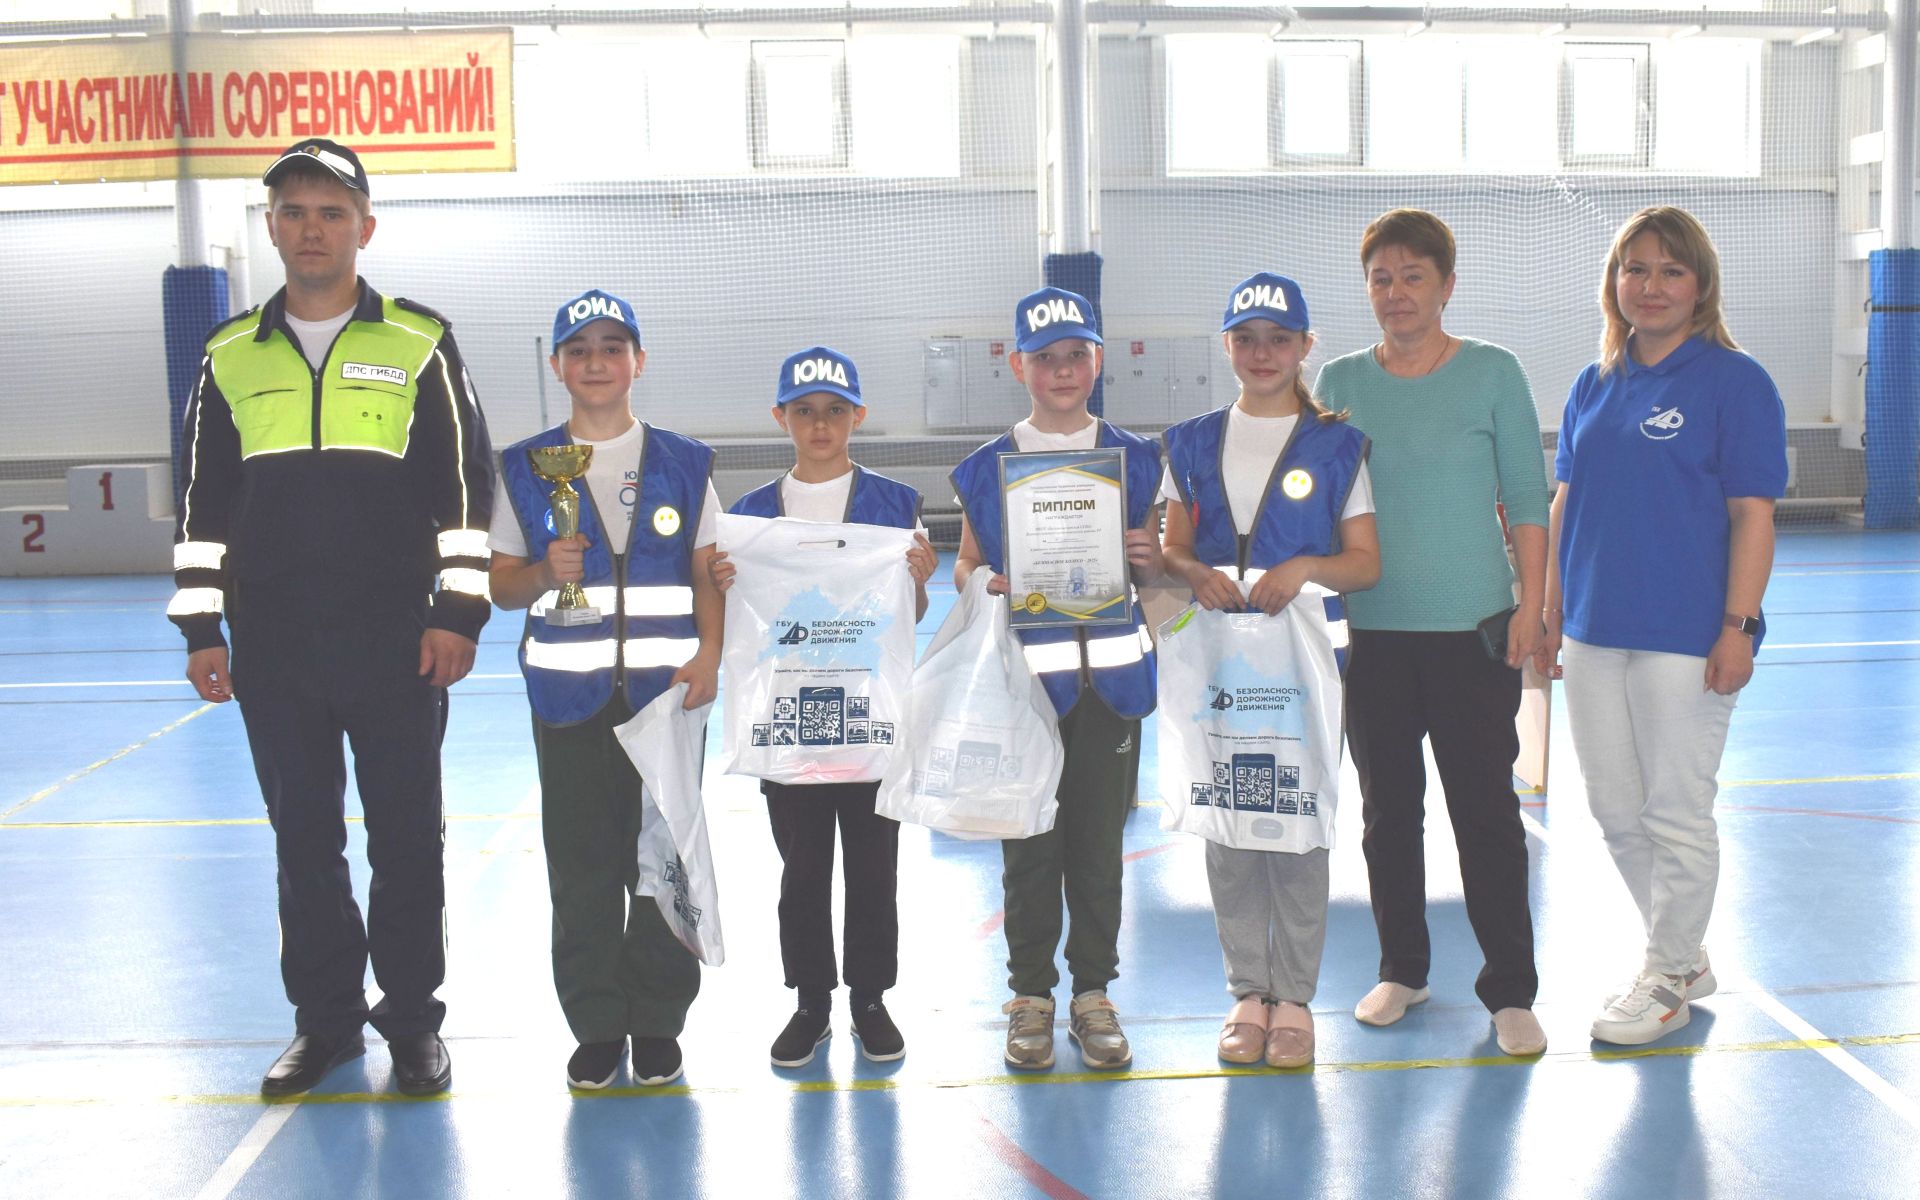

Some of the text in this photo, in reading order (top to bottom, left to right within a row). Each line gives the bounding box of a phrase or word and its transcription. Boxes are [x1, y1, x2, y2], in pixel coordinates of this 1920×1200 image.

[12, 73, 214, 146] УЧАСТНИКАМ
[223, 52, 495, 138] СОРЕВНОВАНИЙ!
[568, 297, 625, 325] ЮИД
[1234, 285, 1288, 314] ЮИД
[1026, 299, 1085, 333] ЮИД
[344, 365, 404, 381] ДПС ГИБДД
[794, 358, 849, 387] ЮИД
[1132, 369, 1143, 377] 10
[99, 471, 115, 510] 1
[1032, 499, 1096, 513] ДИПЛОМ
[22, 513, 46, 553] 2
[811, 628, 863, 636] ДОРОЖНОГО
[1236, 687, 1301, 695] БЕЗОПАСНОСТЬ
[1236, 695, 1291, 704] ДОРОЖНОГО
